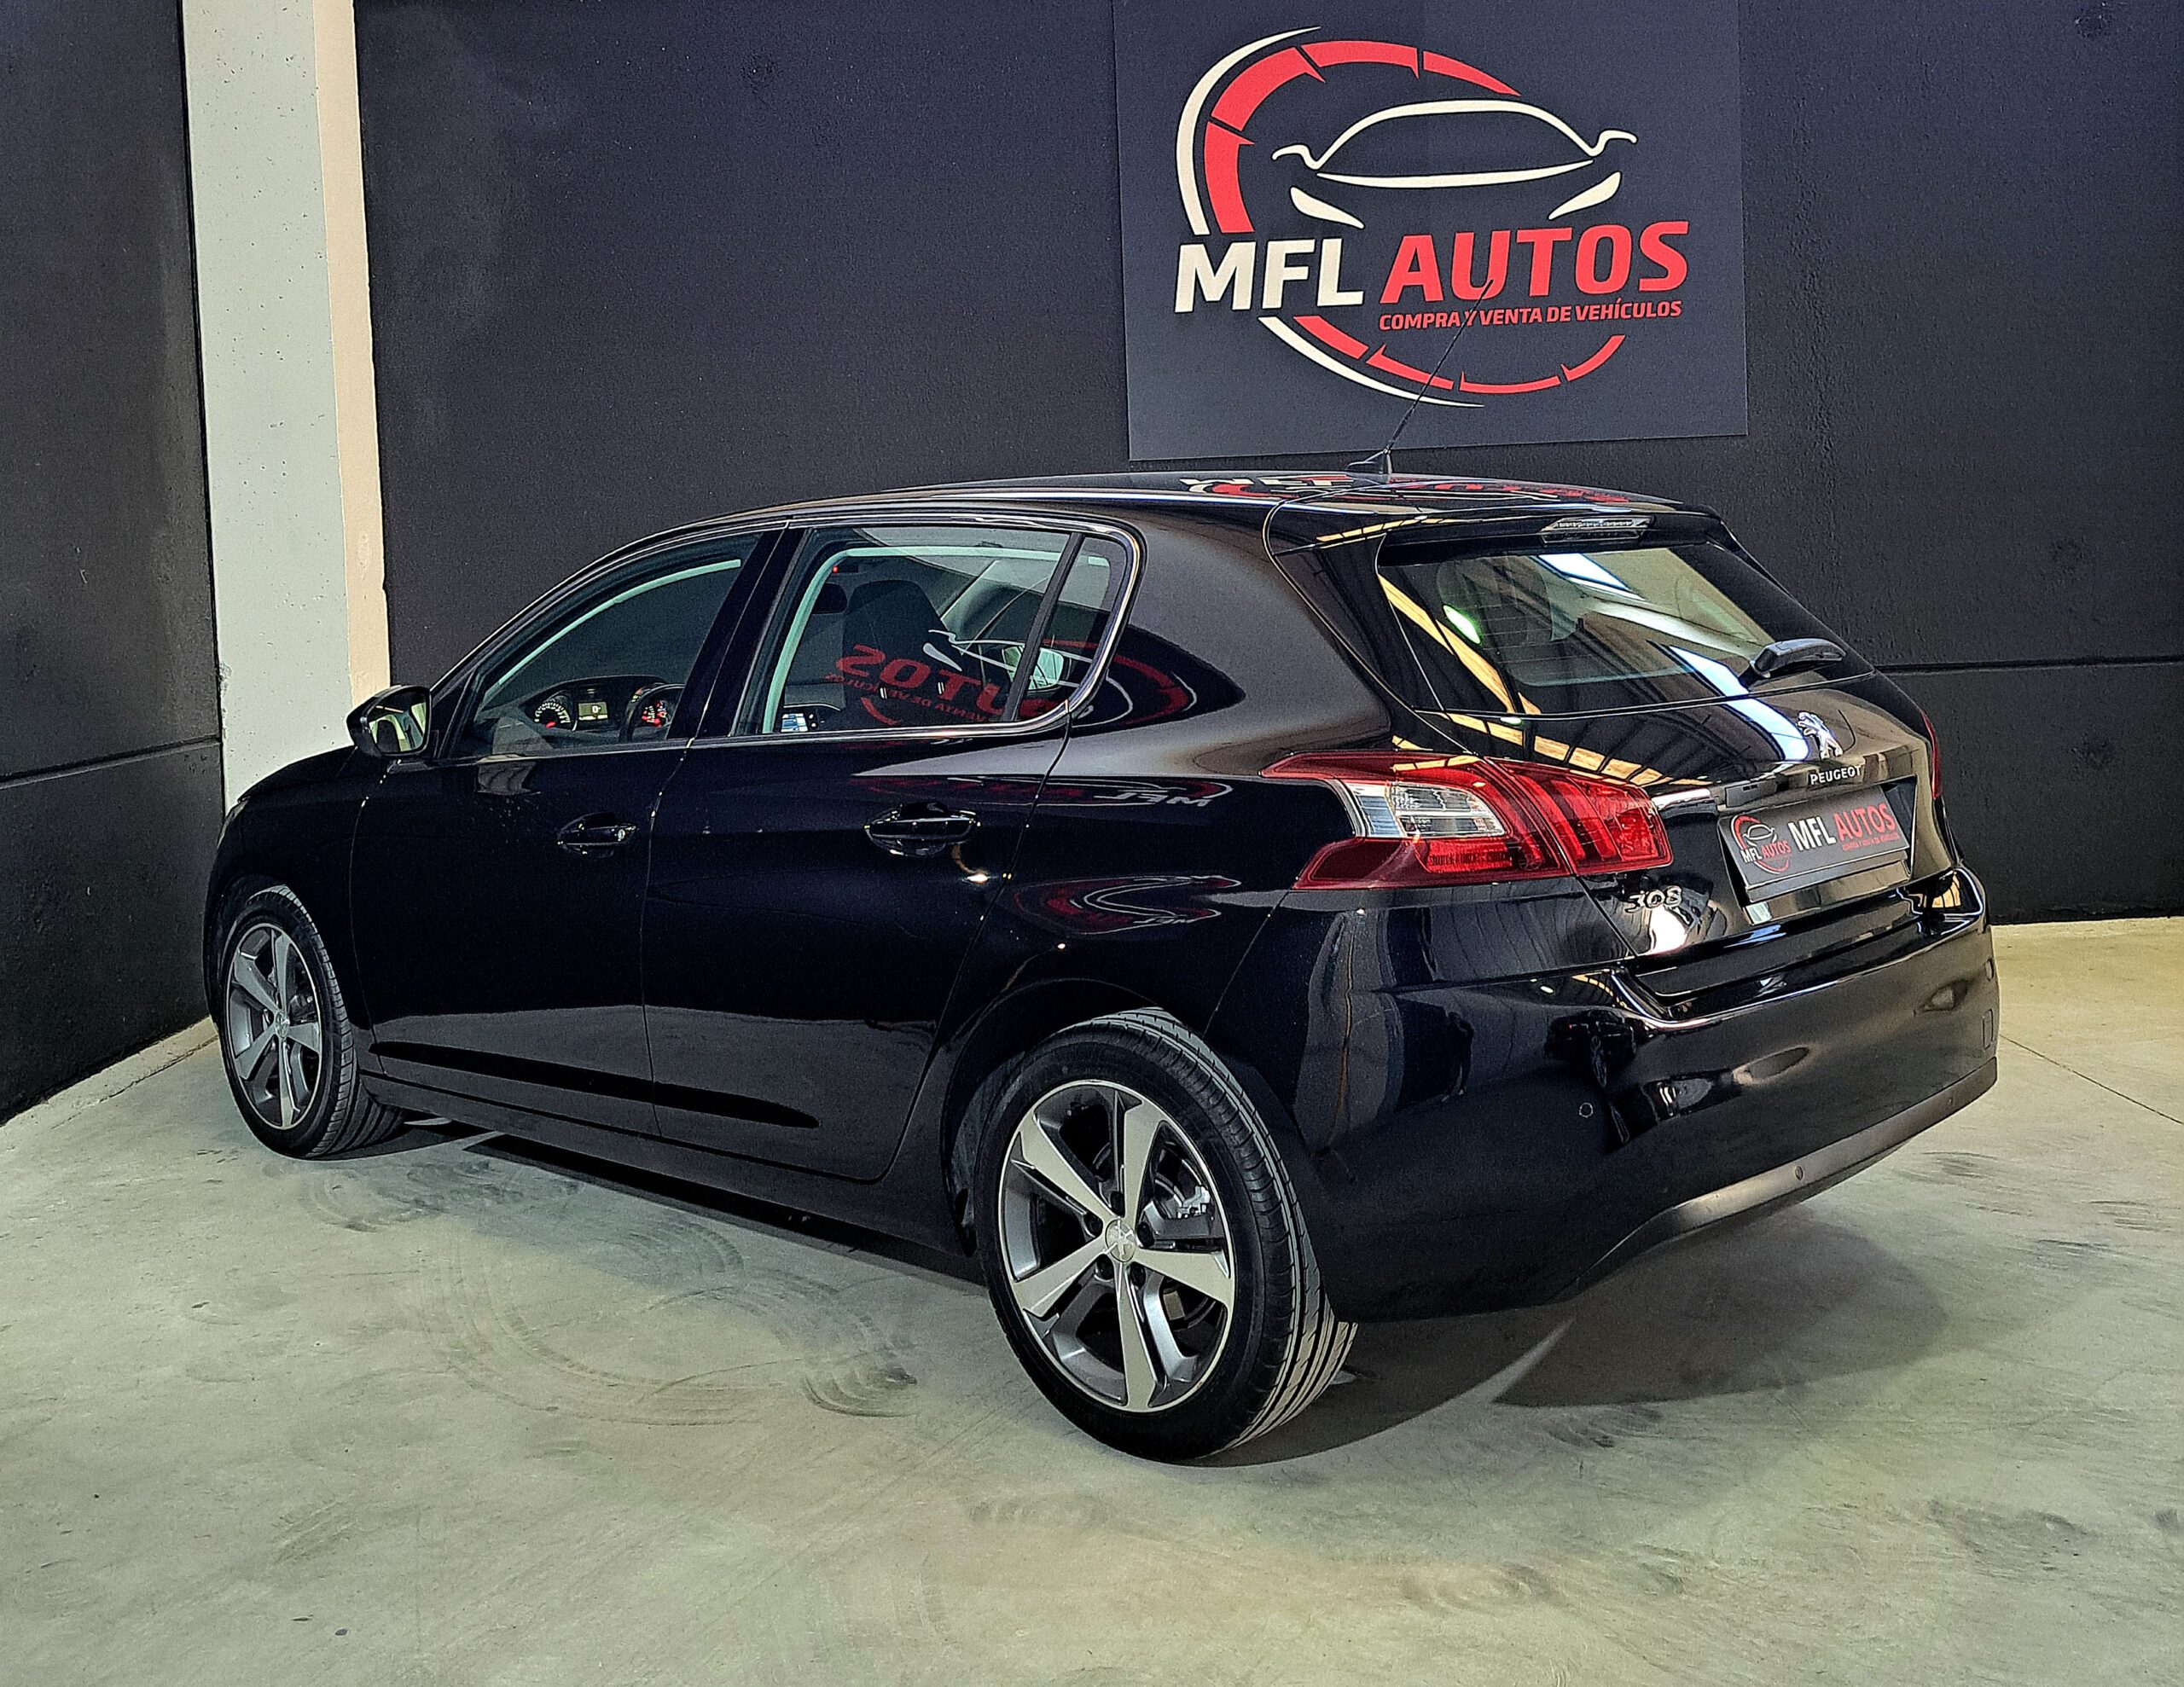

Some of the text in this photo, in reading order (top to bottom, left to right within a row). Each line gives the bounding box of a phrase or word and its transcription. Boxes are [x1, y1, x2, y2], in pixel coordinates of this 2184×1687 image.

[1175, 221, 1689, 313] MFL AUTOS
[1379, 298, 1682, 331] COMPRA Y VENTA DE VEHÍCULOS
[1809, 764, 1862, 785] PEUGEOT
[1788, 817, 1836, 851] MFL
[1833, 803, 1896, 841] AUTOS
[1740, 847, 1763, 863] MFL
[1762, 840, 1792, 859] AUTOS
[1625, 885, 1682, 913] 308
